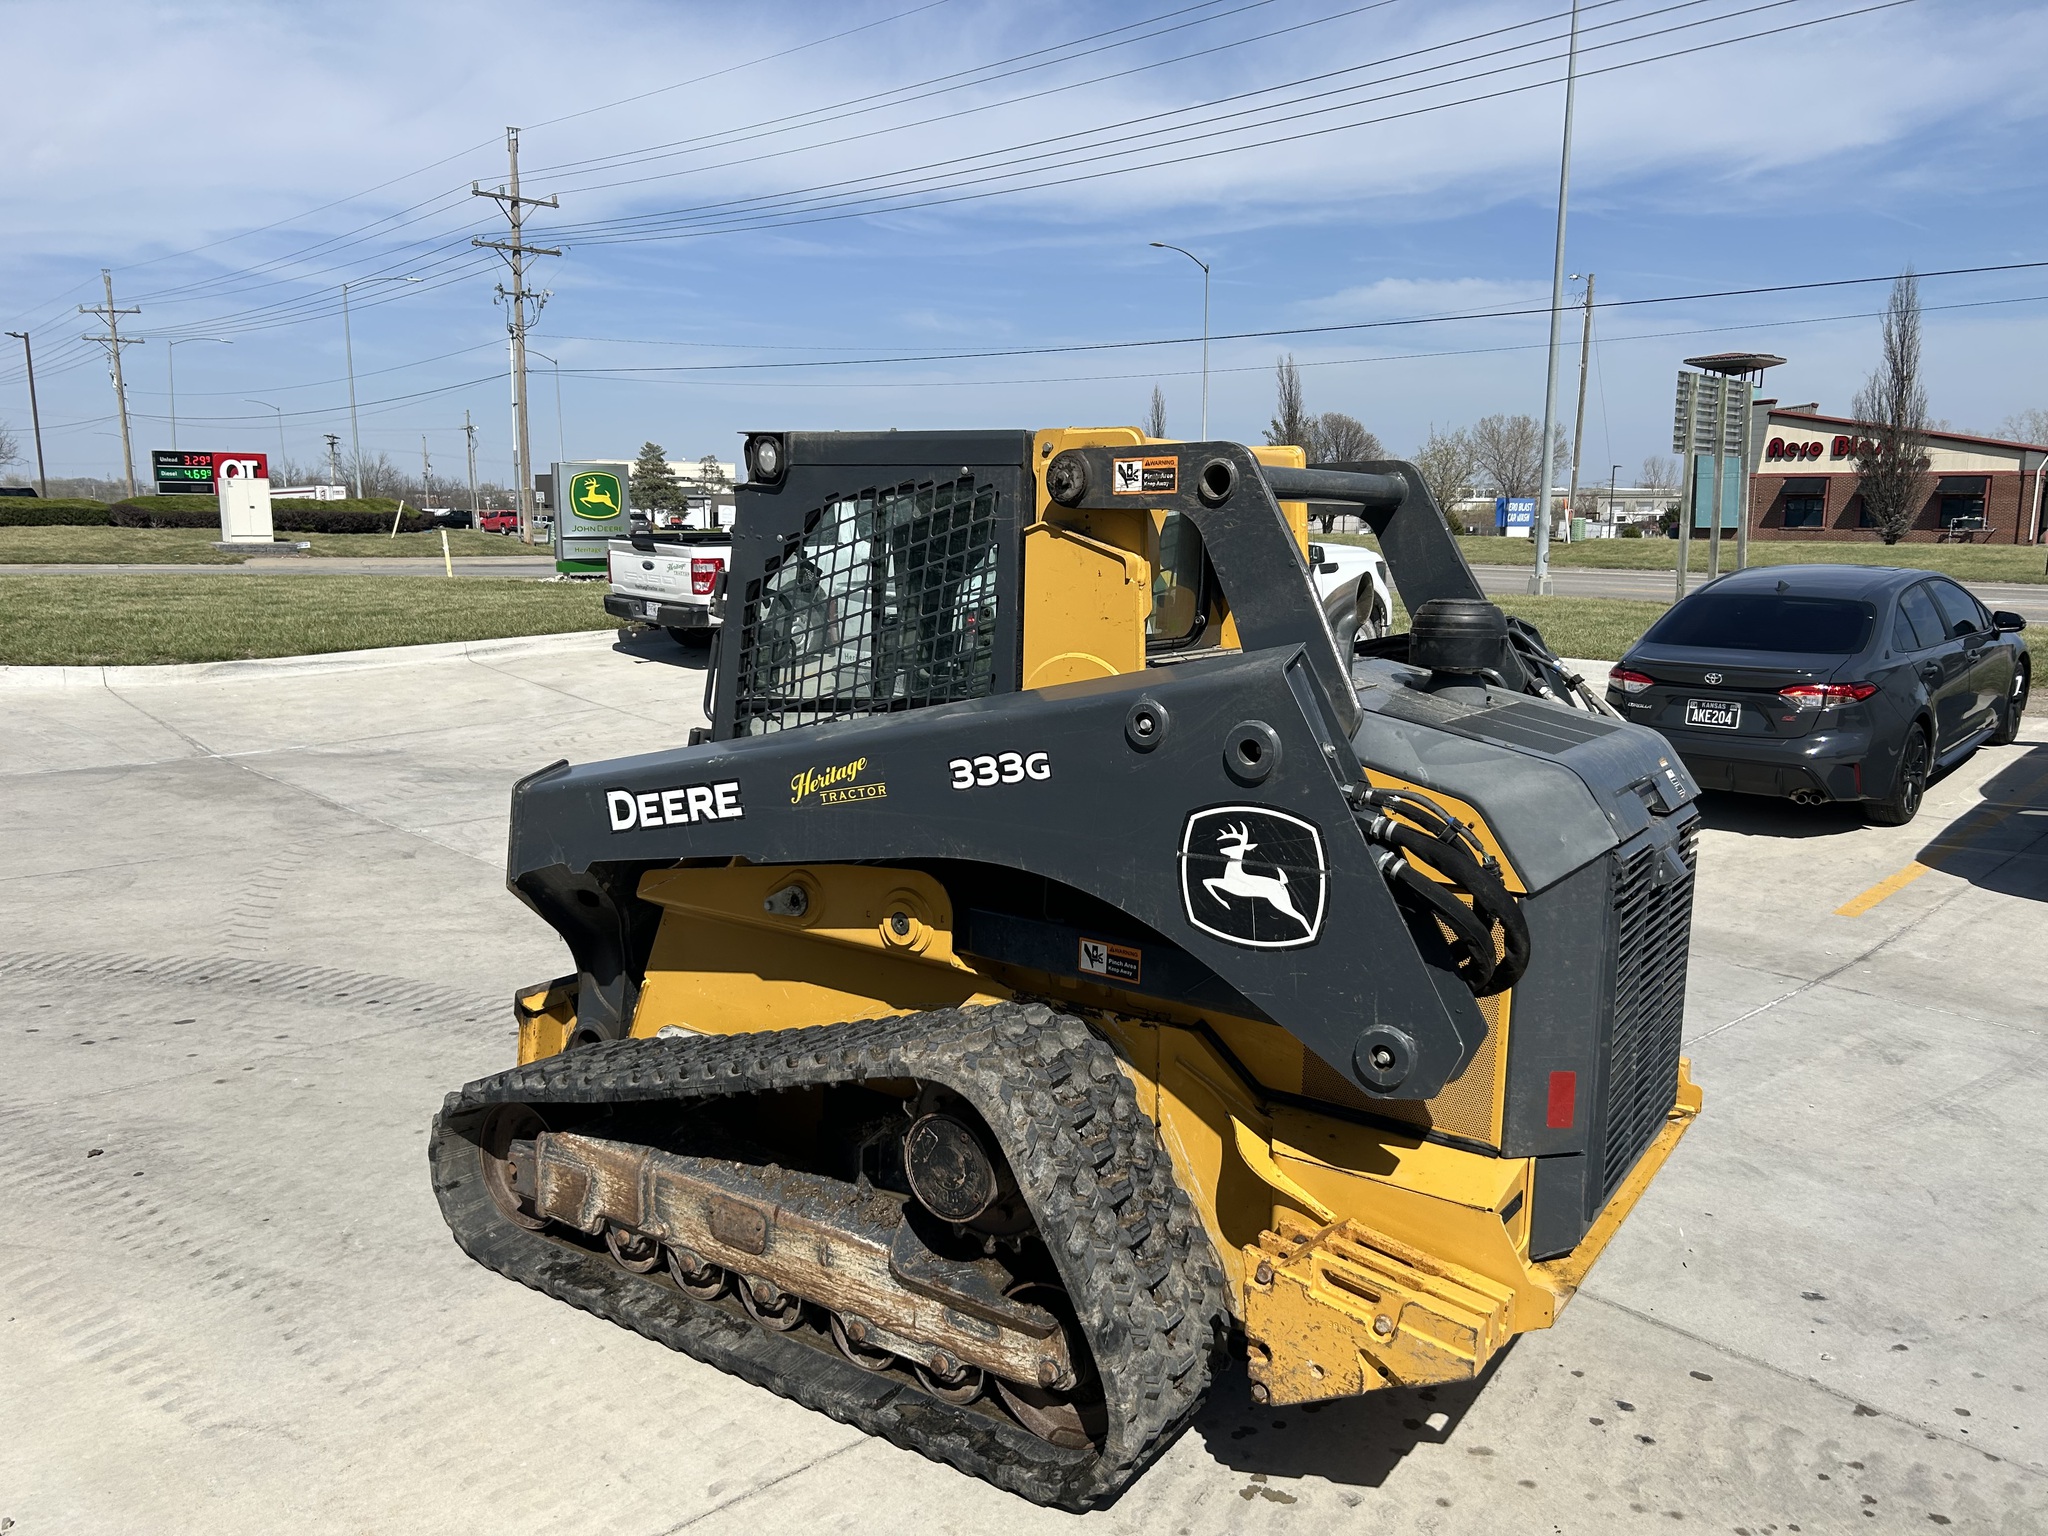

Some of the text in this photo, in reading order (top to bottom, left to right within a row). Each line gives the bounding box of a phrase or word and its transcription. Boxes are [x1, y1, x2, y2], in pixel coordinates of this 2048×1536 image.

[1768, 435, 1894, 458] Aero Bla
[219, 459, 258, 479] QT
[1507, 502, 1533, 512] ERO BLAST
[1507, 513, 1530, 522] CAR WASH
[1701, 702, 1727, 710] KANSAS
[1691, 709, 1732, 725] AKE204
[949, 751, 1051, 790] 333G
[791, 757, 868, 804] Heritage
[820, 785, 887, 803] TRACTOR
[606, 782, 743, 831] DEERE
[1108, 959, 1123, 967] Pinch
